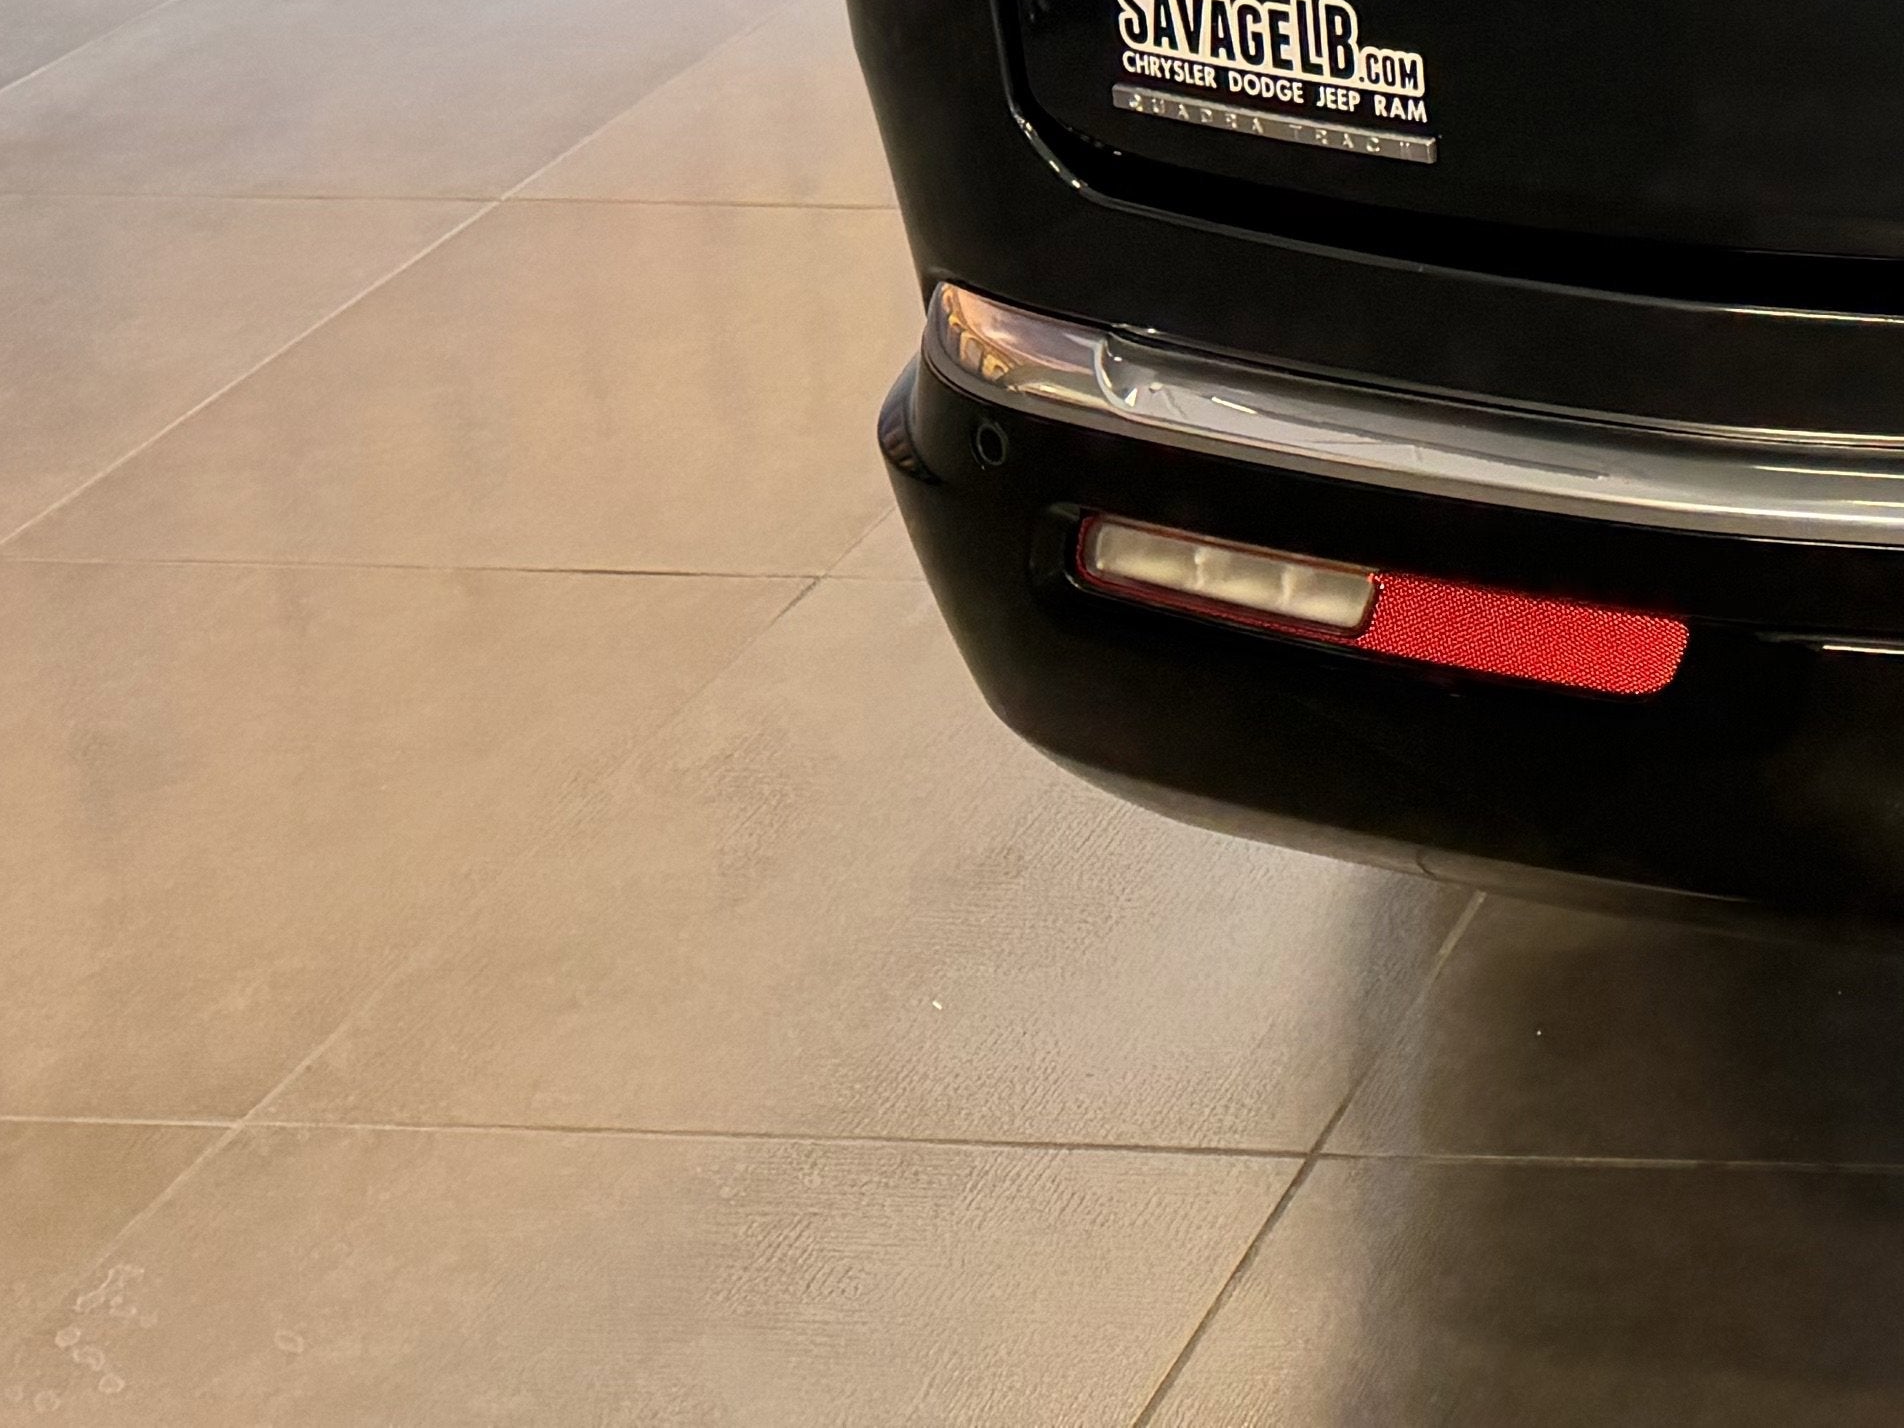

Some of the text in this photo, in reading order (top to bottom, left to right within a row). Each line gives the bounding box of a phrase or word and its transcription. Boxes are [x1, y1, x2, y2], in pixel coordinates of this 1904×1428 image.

[1122, 50, 1428, 123] CHRYSLER DODGE JEEP RAM
[1128, 92, 1265, 135] QUADRA
[1288, 122, 1381, 153] TRAC
